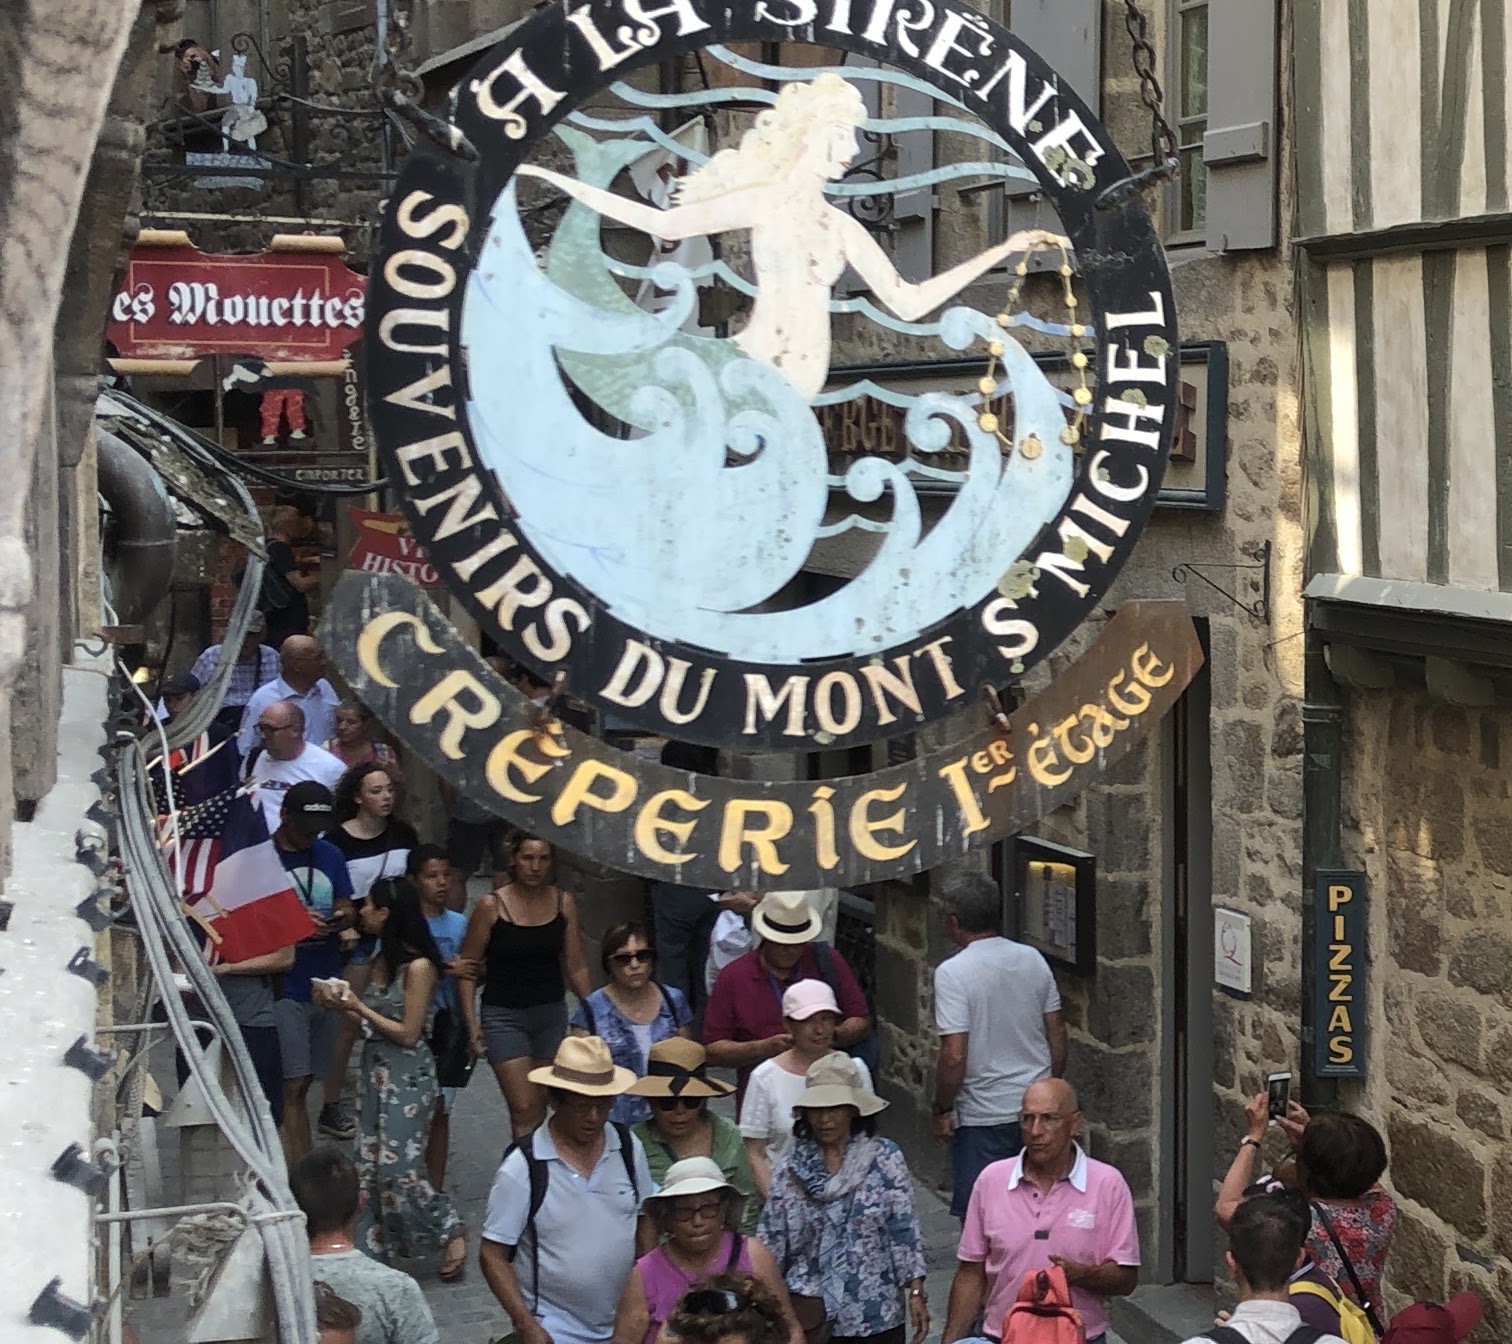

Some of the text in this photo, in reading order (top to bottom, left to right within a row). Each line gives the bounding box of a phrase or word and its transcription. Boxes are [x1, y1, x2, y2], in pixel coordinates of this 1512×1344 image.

[112, 281, 365, 328] es Mouettes
[378, 190, 592, 662] SOUVENIRS
[599, 638, 718, 725] DU
[743, 636, 967, 737] MONT
[1035, 290, 1168, 599] MICHEL
[361, 552, 438, 584] HISTO
[1328, 885, 1353, 1065] PIZZAS
